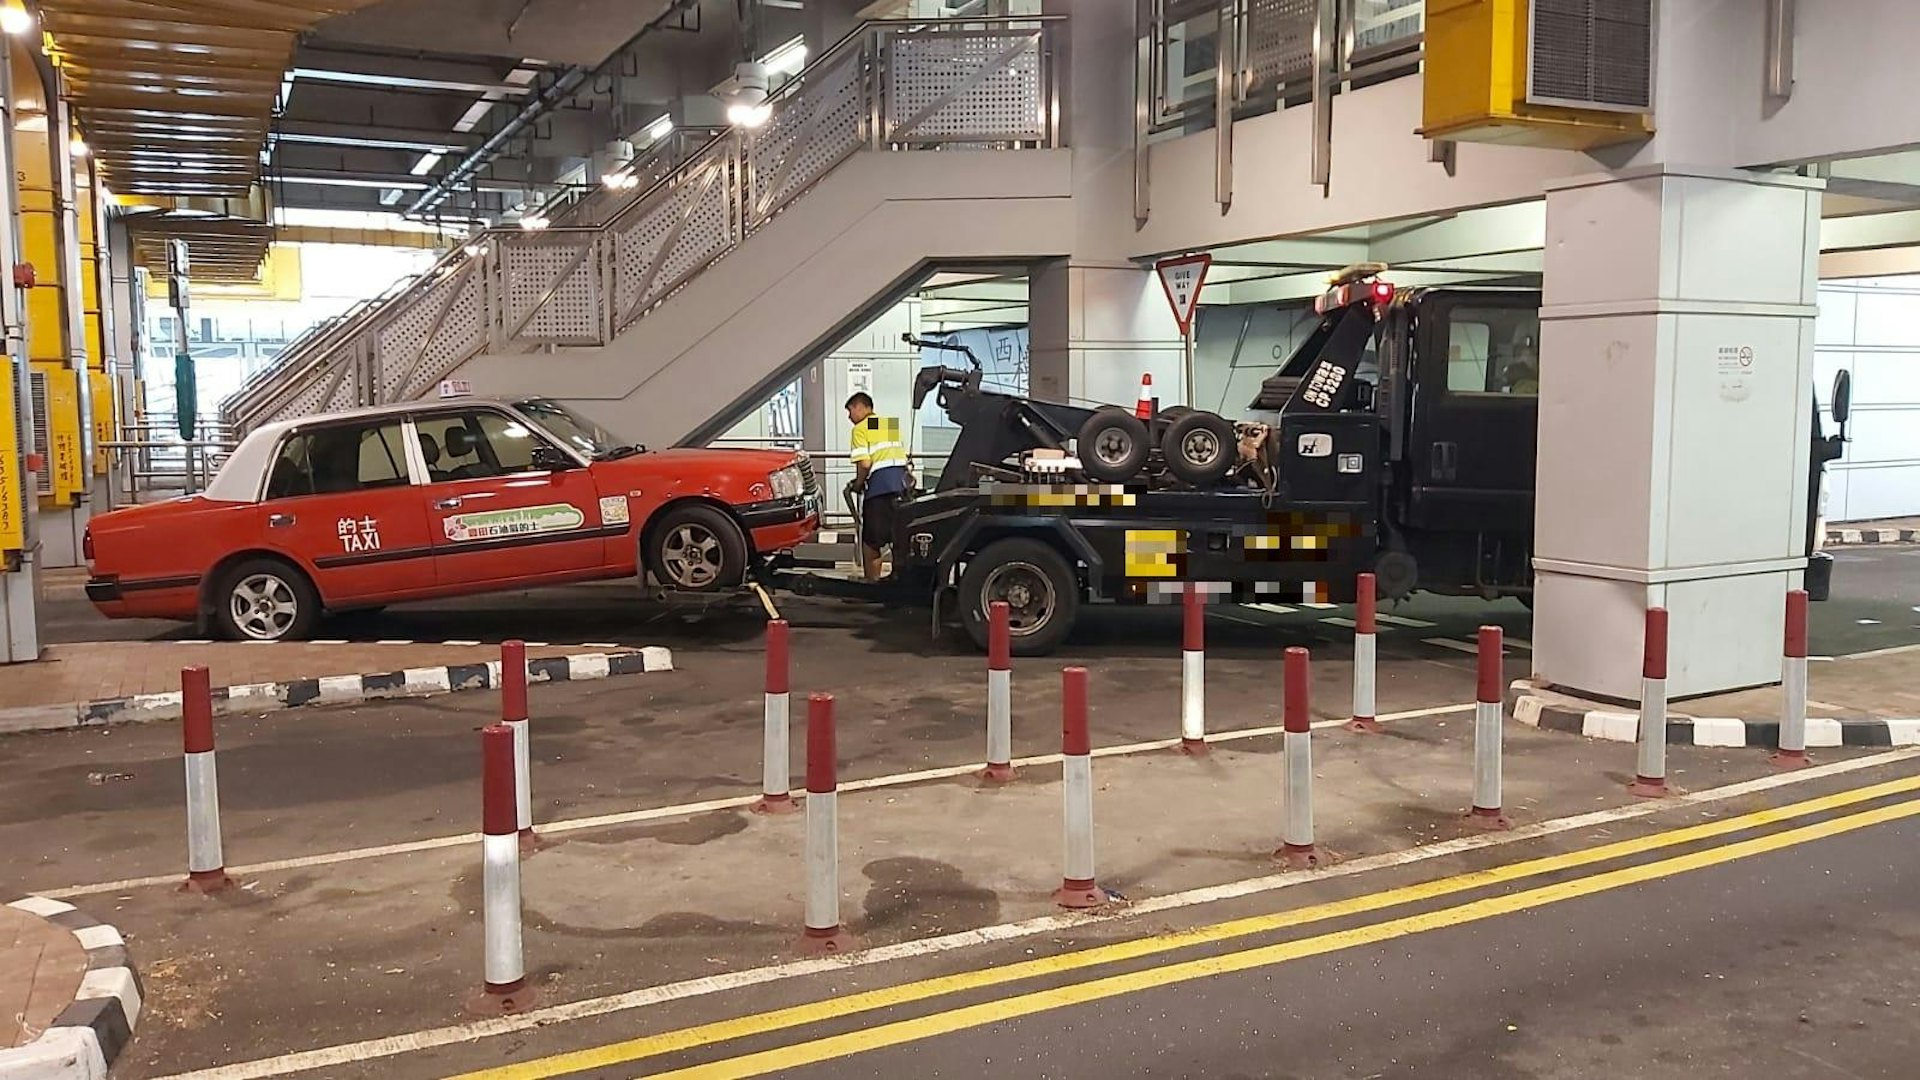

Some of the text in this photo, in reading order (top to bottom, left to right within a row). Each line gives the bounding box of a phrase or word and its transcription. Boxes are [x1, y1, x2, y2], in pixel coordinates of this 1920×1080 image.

[1175, 270, 1190, 280] GIVE
[1176, 281, 1190, 289] WAY
[338, 515, 377, 535] 的士
[339, 532, 380, 552] TAXI
